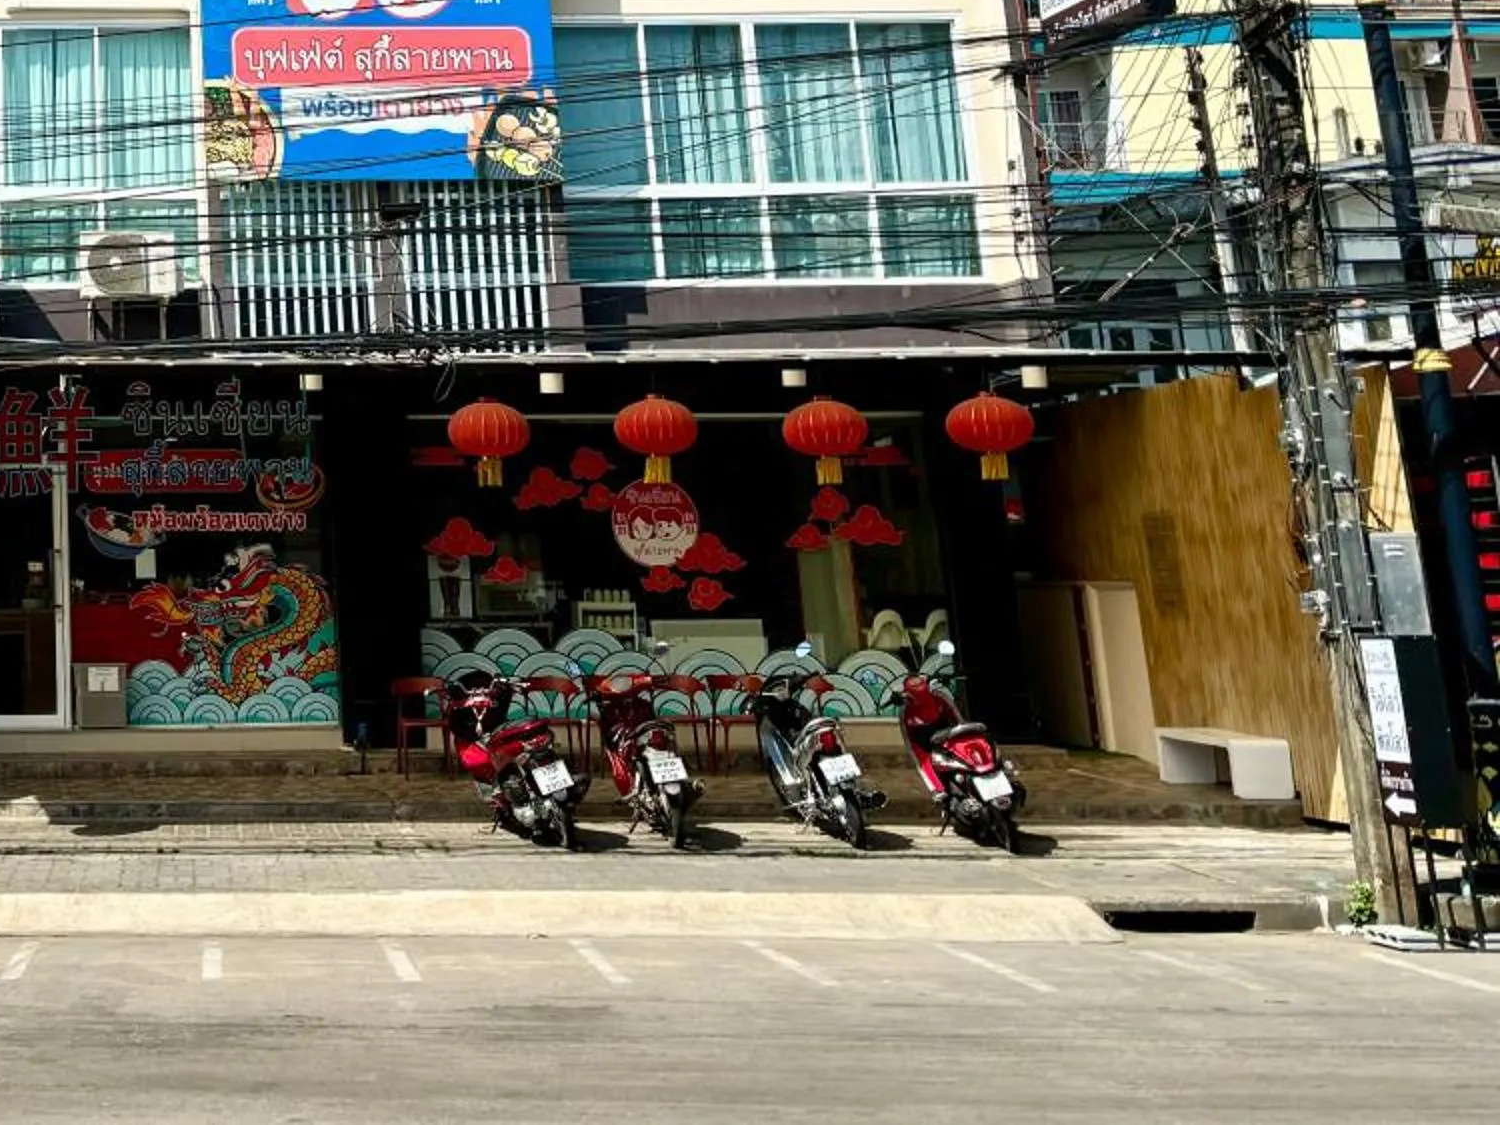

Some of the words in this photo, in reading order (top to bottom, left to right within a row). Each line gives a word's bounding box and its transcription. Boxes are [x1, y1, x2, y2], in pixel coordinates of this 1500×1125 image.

[244, 38, 345, 79] บุฟเฟ่ต์
[355, 34, 514, 81] สุกี้สายพาน
